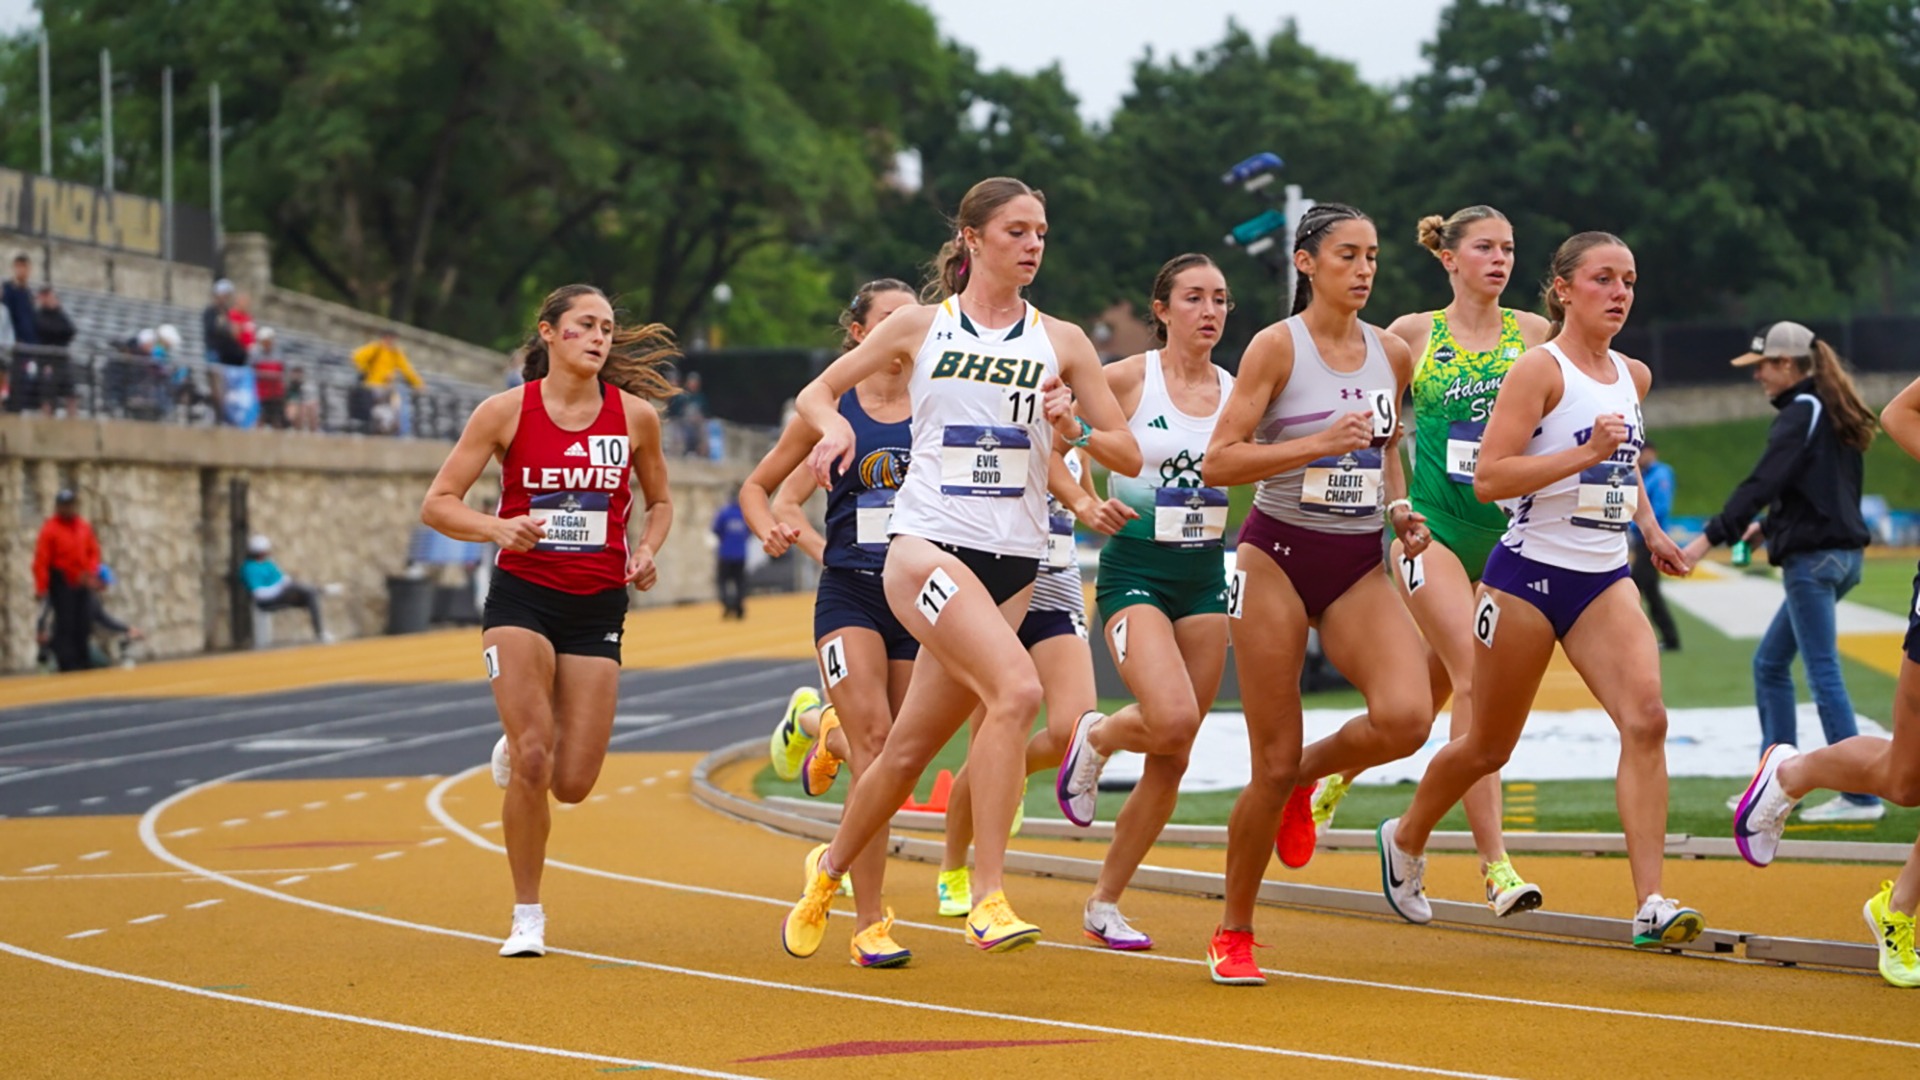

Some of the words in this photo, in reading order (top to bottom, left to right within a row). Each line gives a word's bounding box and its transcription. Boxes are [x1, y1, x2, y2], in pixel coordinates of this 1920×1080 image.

[930, 350, 1045, 389] BHSU
[1443, 376, 1502, 405] Adam
[1008, 391, 1036, 424] 11
[1376, 393, 1393, 434] 9
[596, 438, 623, 465] 10
[976, 454, 999, 468] EVIE
[522, 466, 622, 489] LEWIS
[972, 470, 1001, 484] BOYD
[1328, 474, 1364, 488] ELIETTE
[1324, 489, 1364, 503] CHAPUT
[1606, 491, 1625, 505] ELLA
[551, 515, 587, 528] MEGAN
[1185, 513, 1204, 525] KIKI
[547, 528, 590, 542] GARRETT
[1403, 556, 1419, 592] 2
[922, 579, 949, 614] 11
[1229, 574, 1240, 615] 9
[1477, 603, 1494, 641] 6
[827, 644, 841, 678] 4
